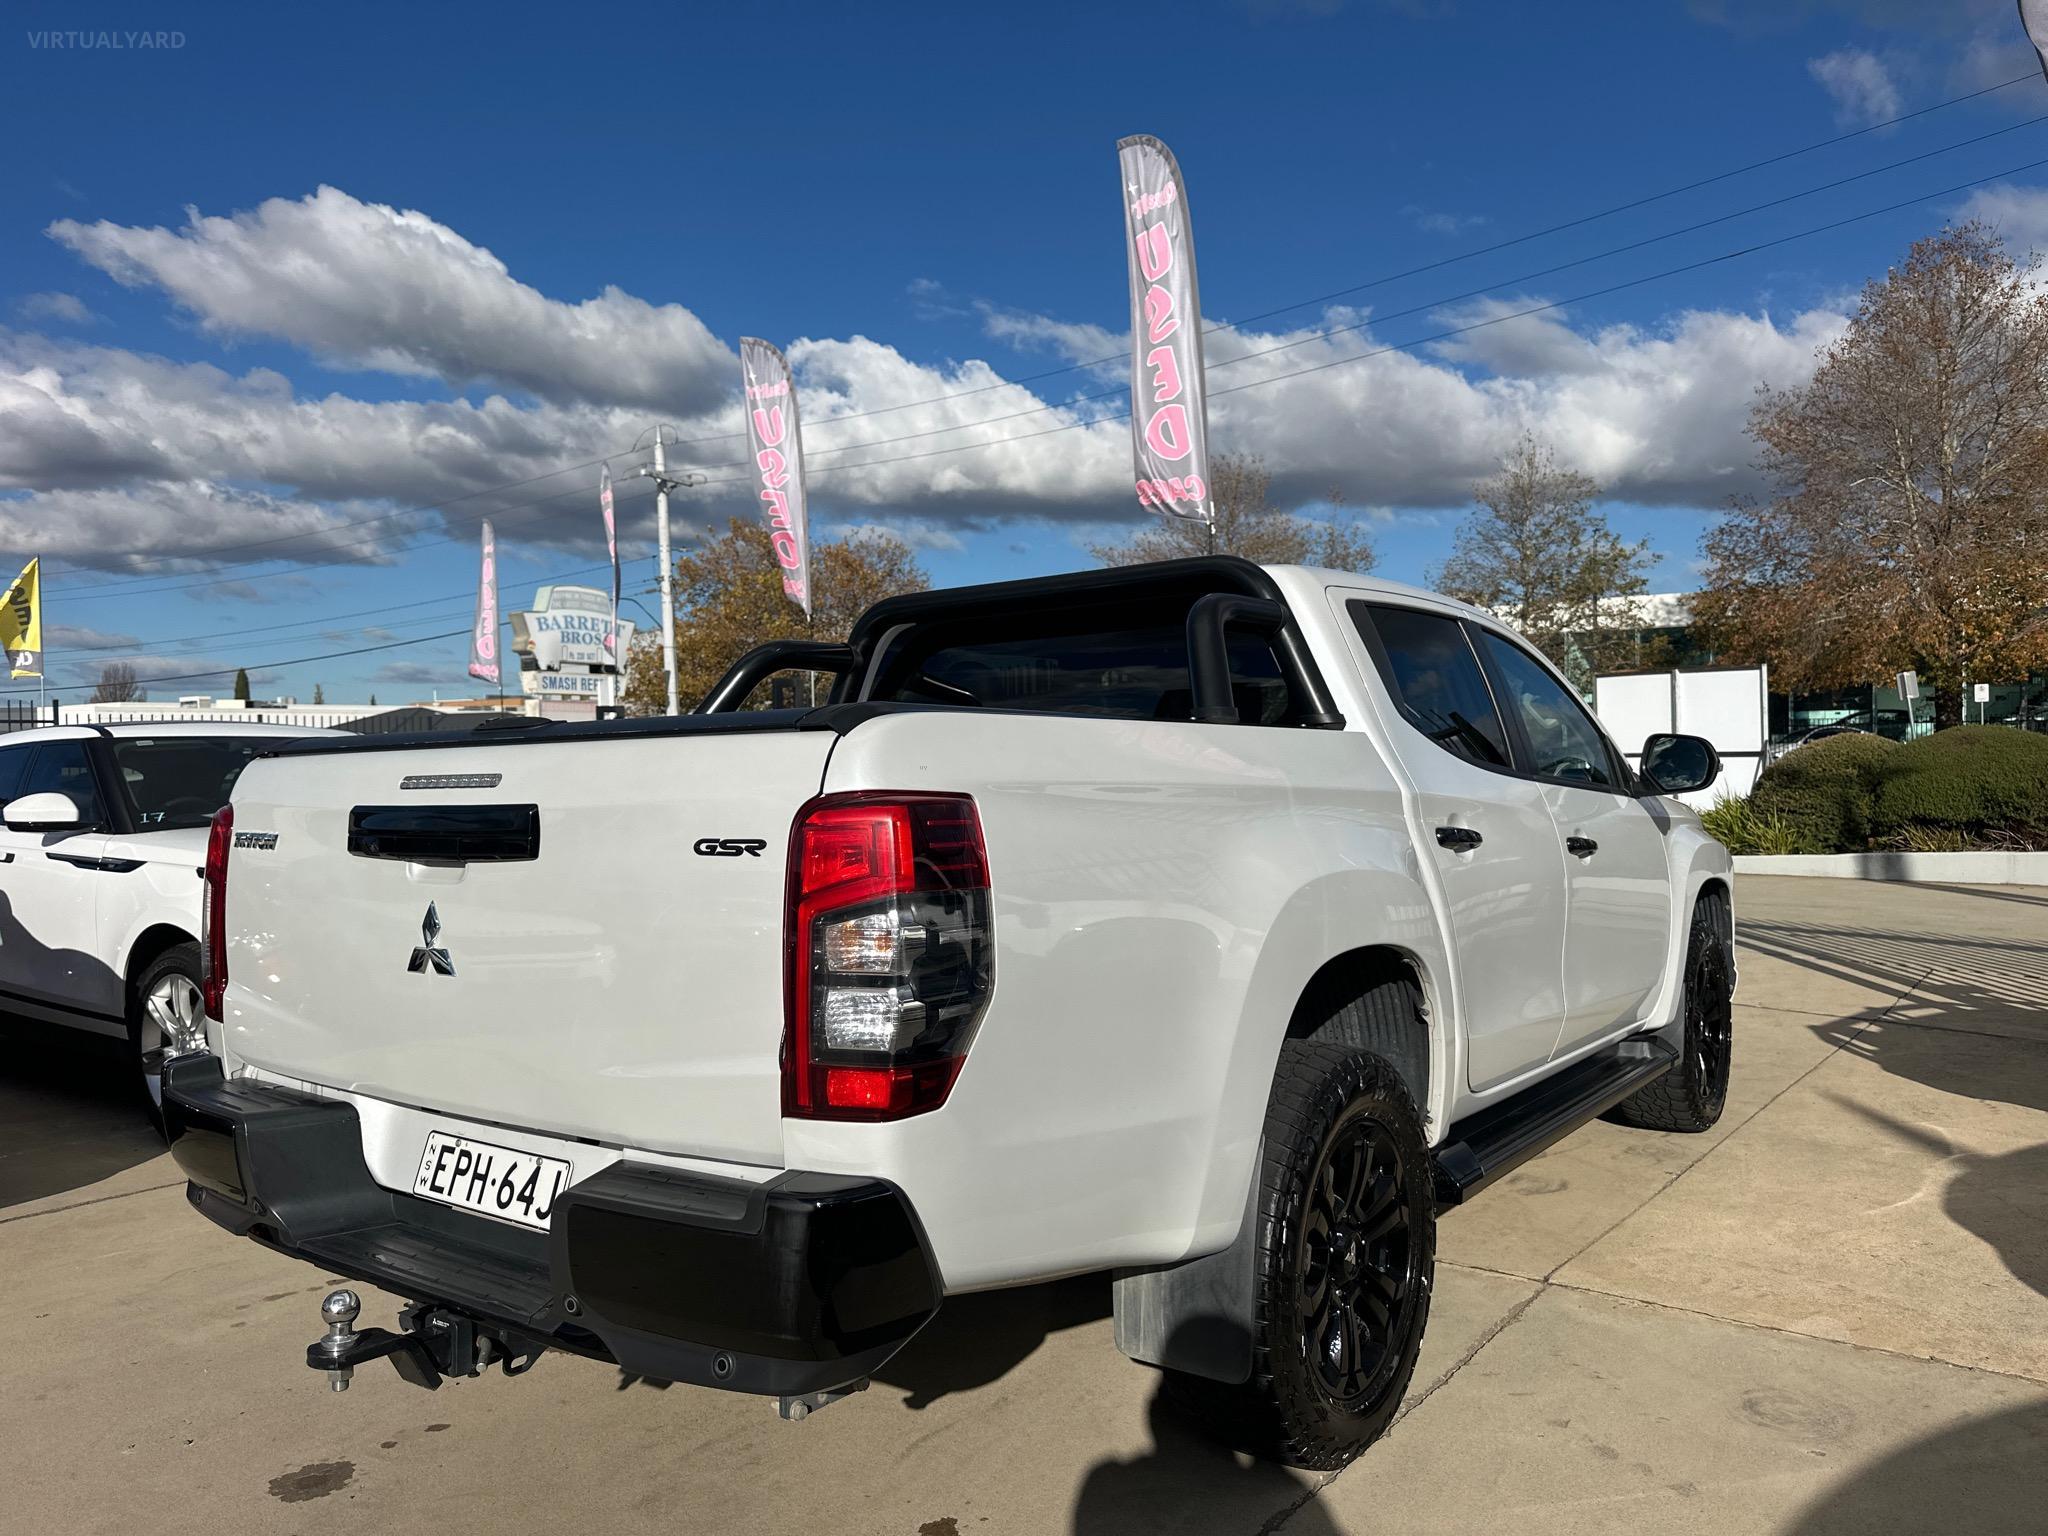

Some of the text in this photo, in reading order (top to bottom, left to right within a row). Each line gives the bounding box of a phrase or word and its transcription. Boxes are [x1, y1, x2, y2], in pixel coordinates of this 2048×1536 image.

[561, 632, 602, 646] BROS
[542, 676, 577, 691] SMASH
[140, 812, 166, 824] 17
[693, 838, 767, 857] GSR
